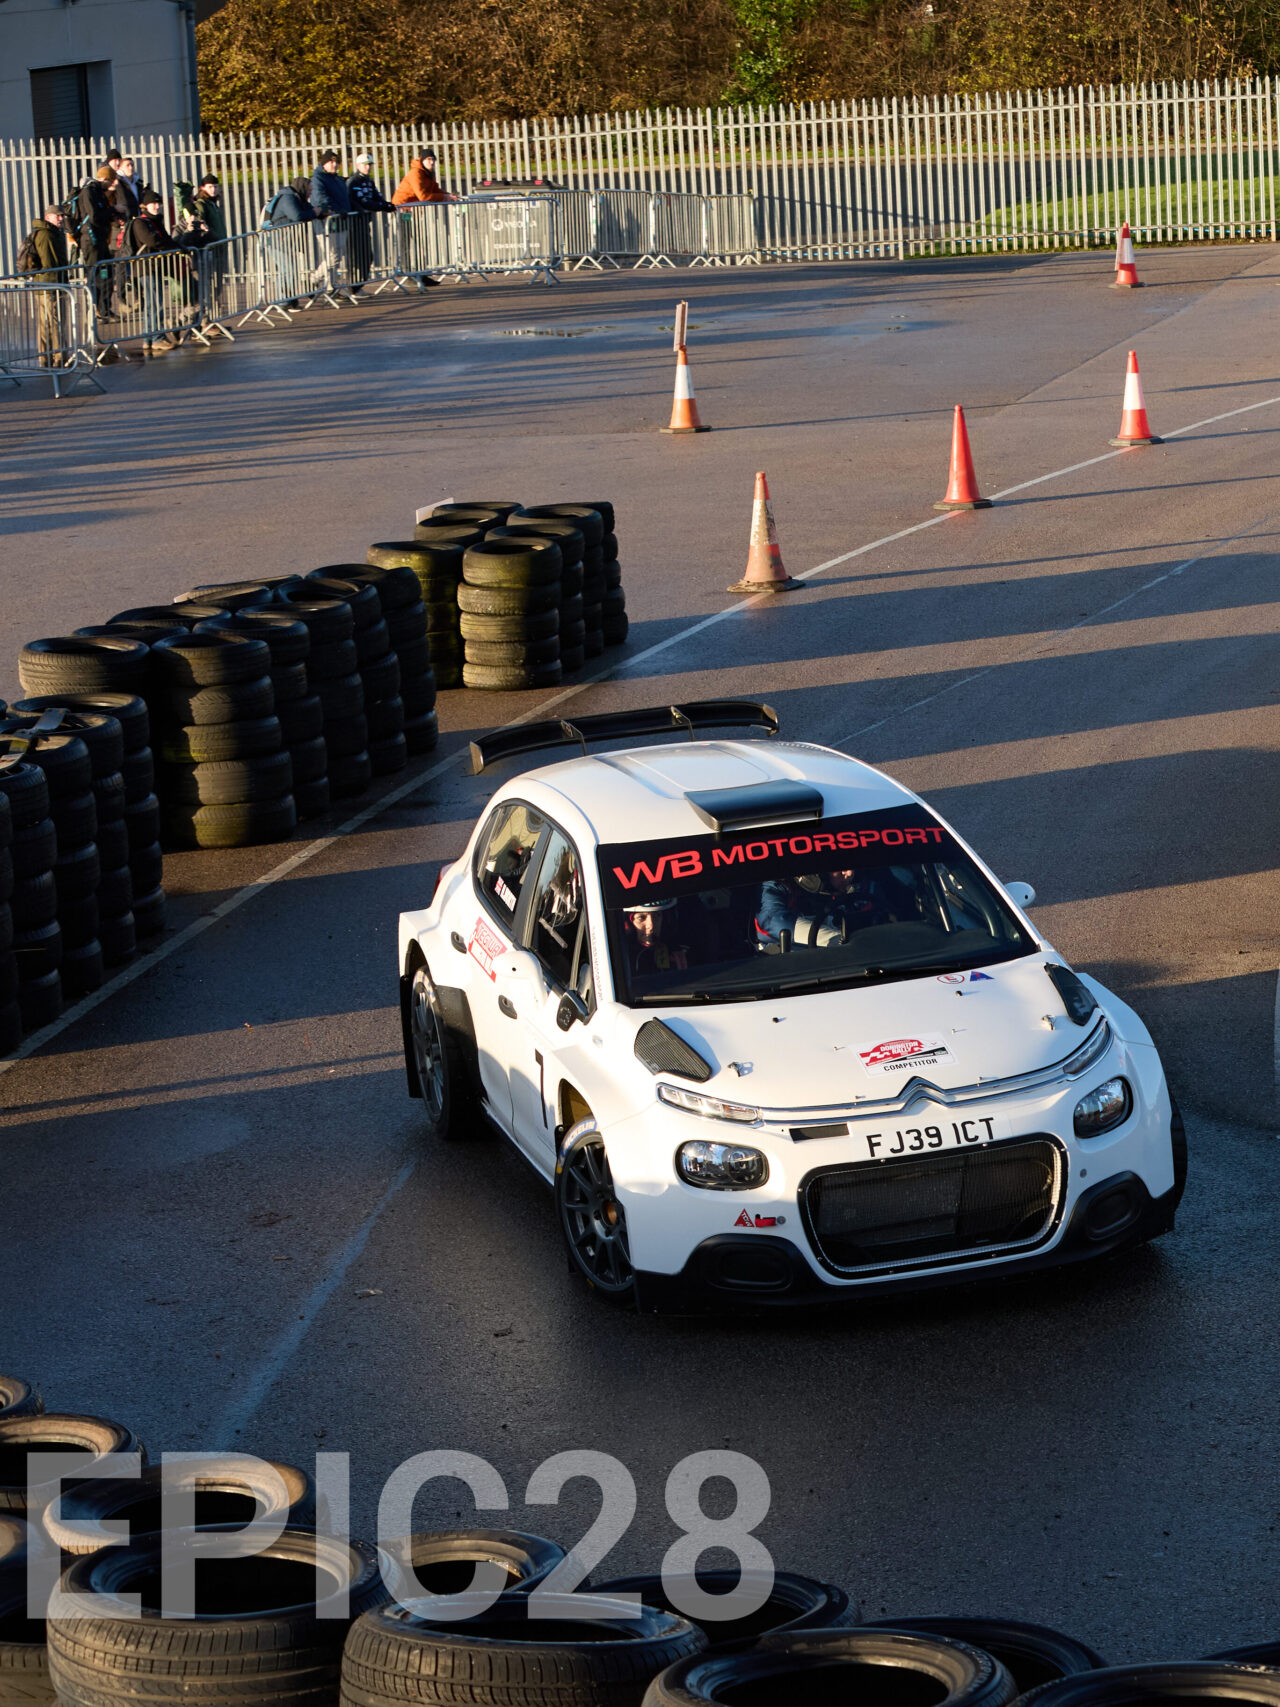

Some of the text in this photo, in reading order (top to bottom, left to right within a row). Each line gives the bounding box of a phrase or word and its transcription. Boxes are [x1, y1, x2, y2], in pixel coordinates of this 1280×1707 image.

[612, 827, 945, 889] WB MOTORSPORT
[883, 1058, 938, 1072] COMPETITOR
[866, 1117, 994, 1158] FJ39 ICT
